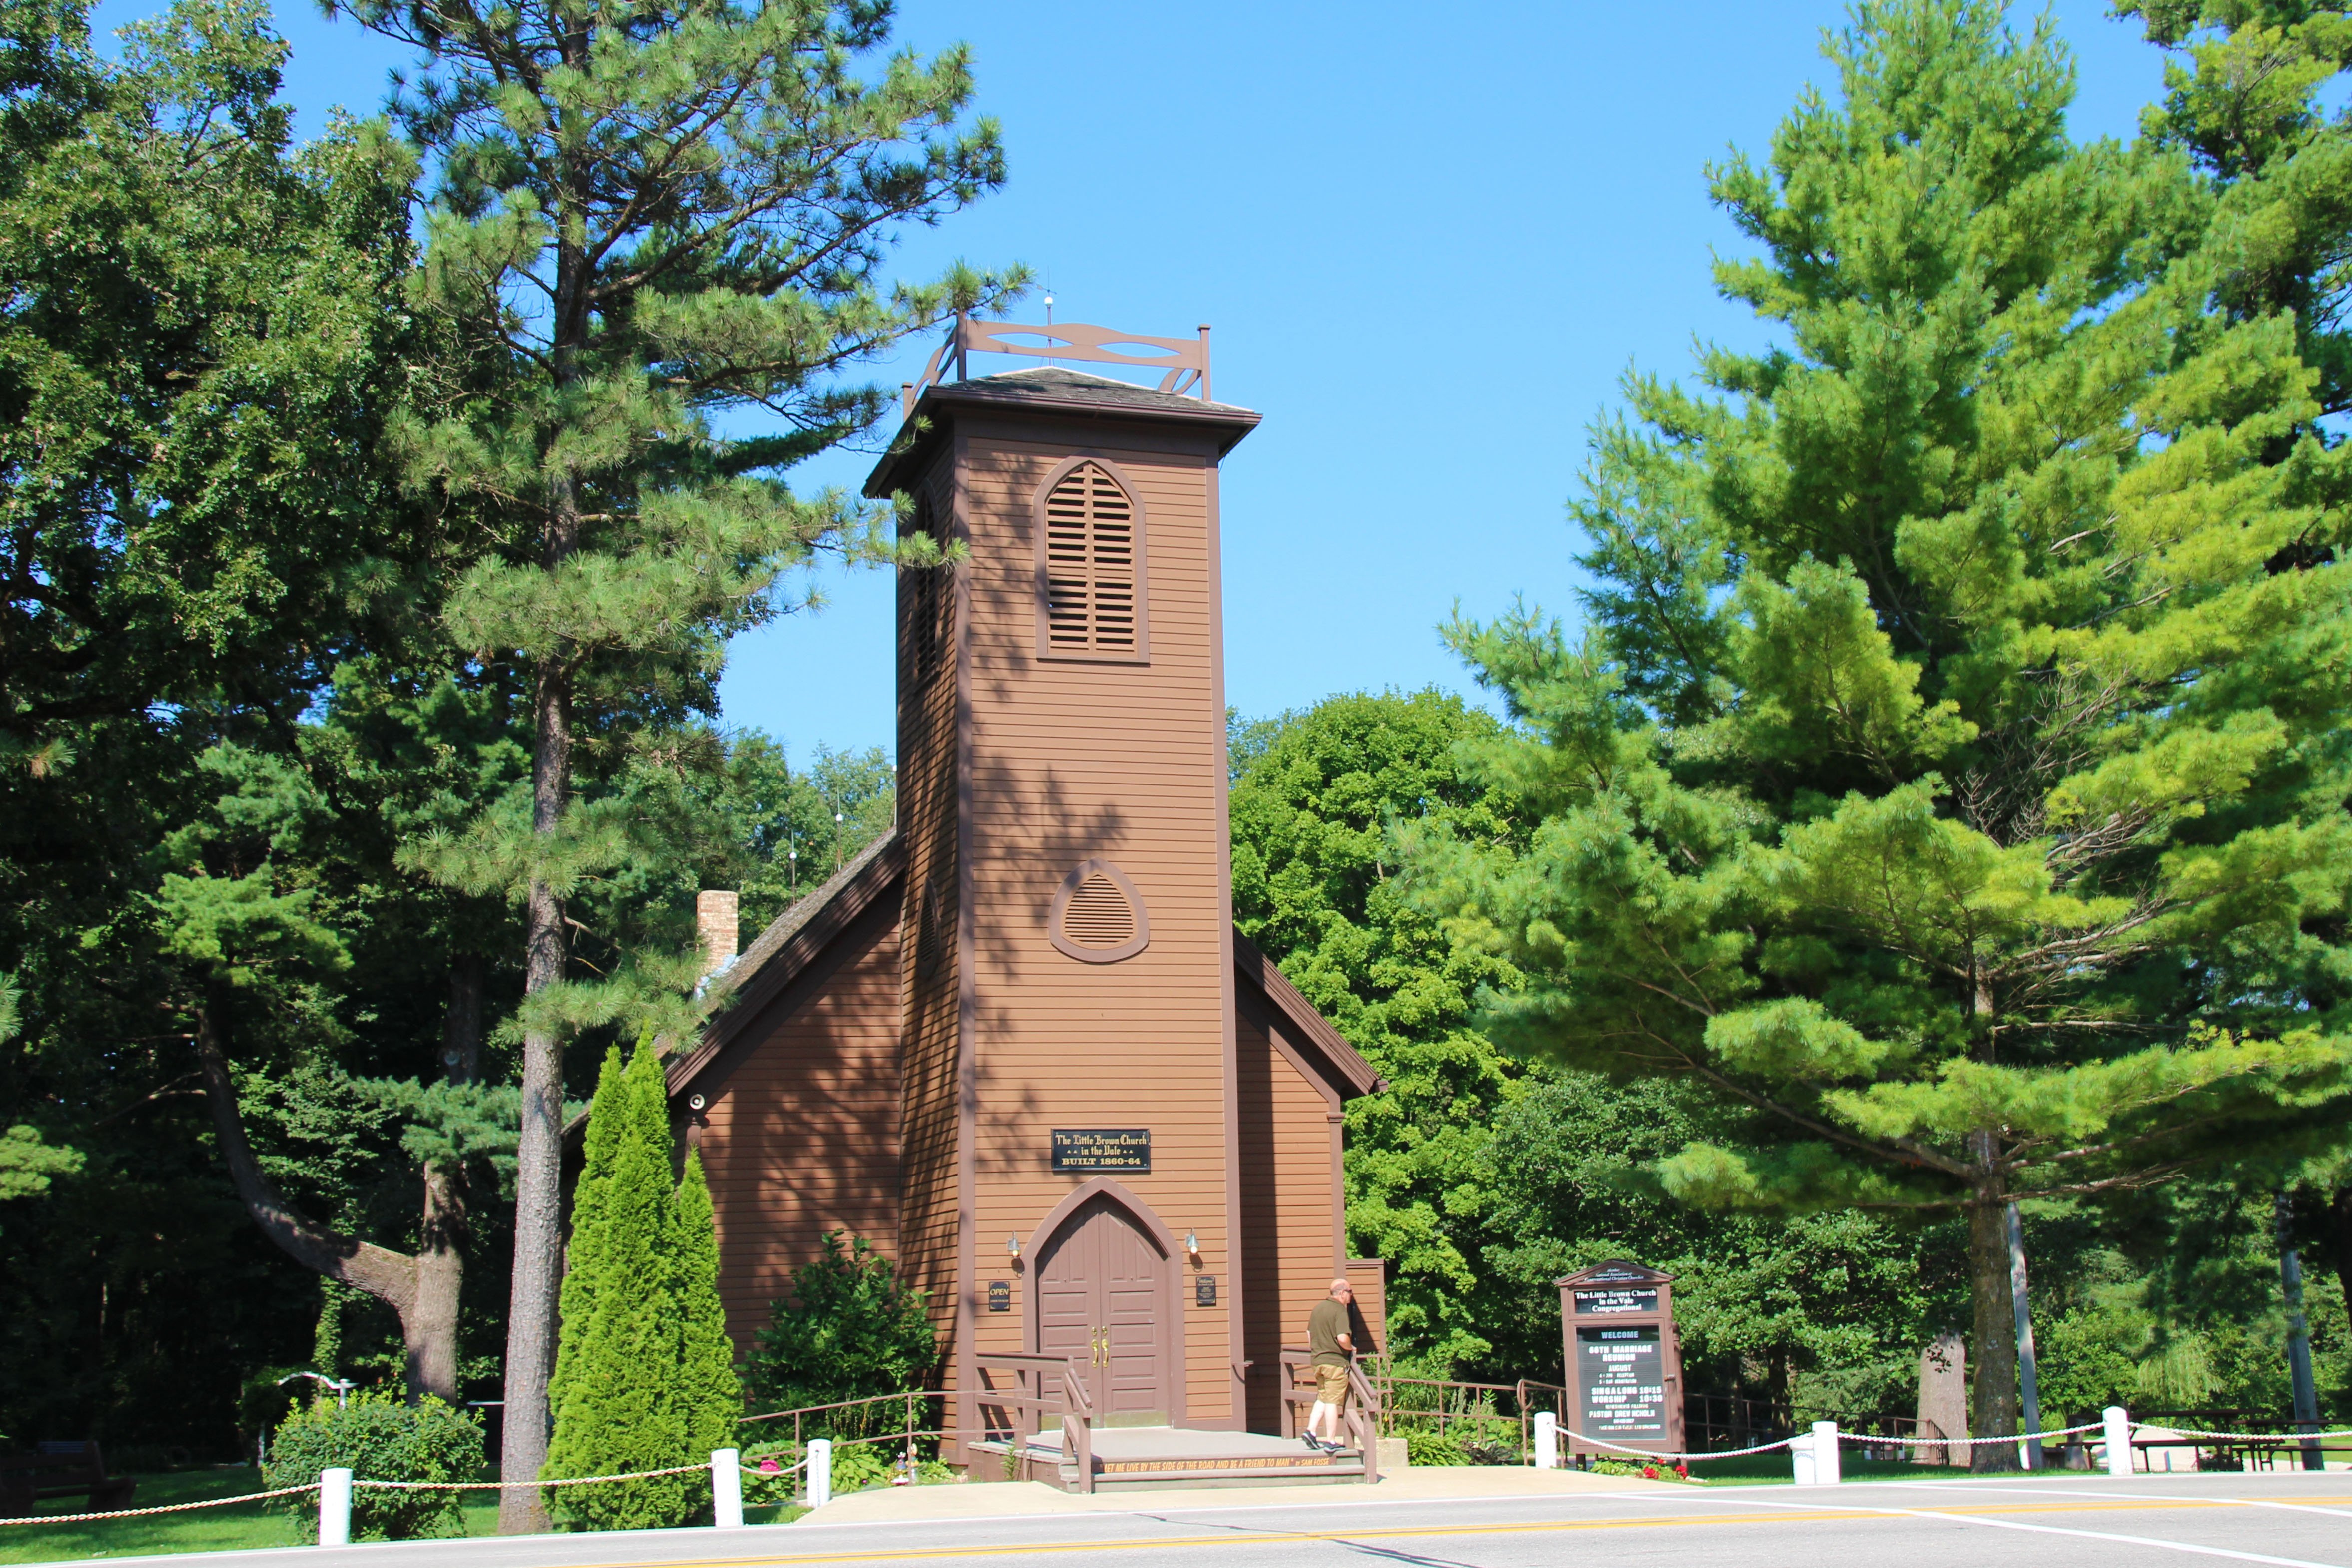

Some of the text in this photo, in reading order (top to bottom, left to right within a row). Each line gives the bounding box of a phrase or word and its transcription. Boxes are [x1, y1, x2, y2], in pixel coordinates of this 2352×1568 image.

[1055, 1134, 1147, 1145] The Little Brown Church
[1081, 1145, 1121, 1156] in the Vale
[1592, 1304, 1642, 1313] Congregational
[1612, 1345, 1652, 1353] MARRIAGE
[1602, 1353, 1635, 1362] REUNION
[1591, 1395, 1627, 1403] WORSHIP
[1115, 1463, 1125, 1472] ME
[1126, 1463, 1139, 1472] LIVE
[1141, 1463, 1148, 1471] BY
[1149, 1462, 1161, 1471] THE
[1162, 1462, 1176, 1471] SIDE
[1186, 1461, 1197, 1470] THE
[1198, 1461, 1215, 1469] ROAD
[1216, 1460, 1229, 1469] AND
[1245, 1459, 1266, 1468] FRIEND
